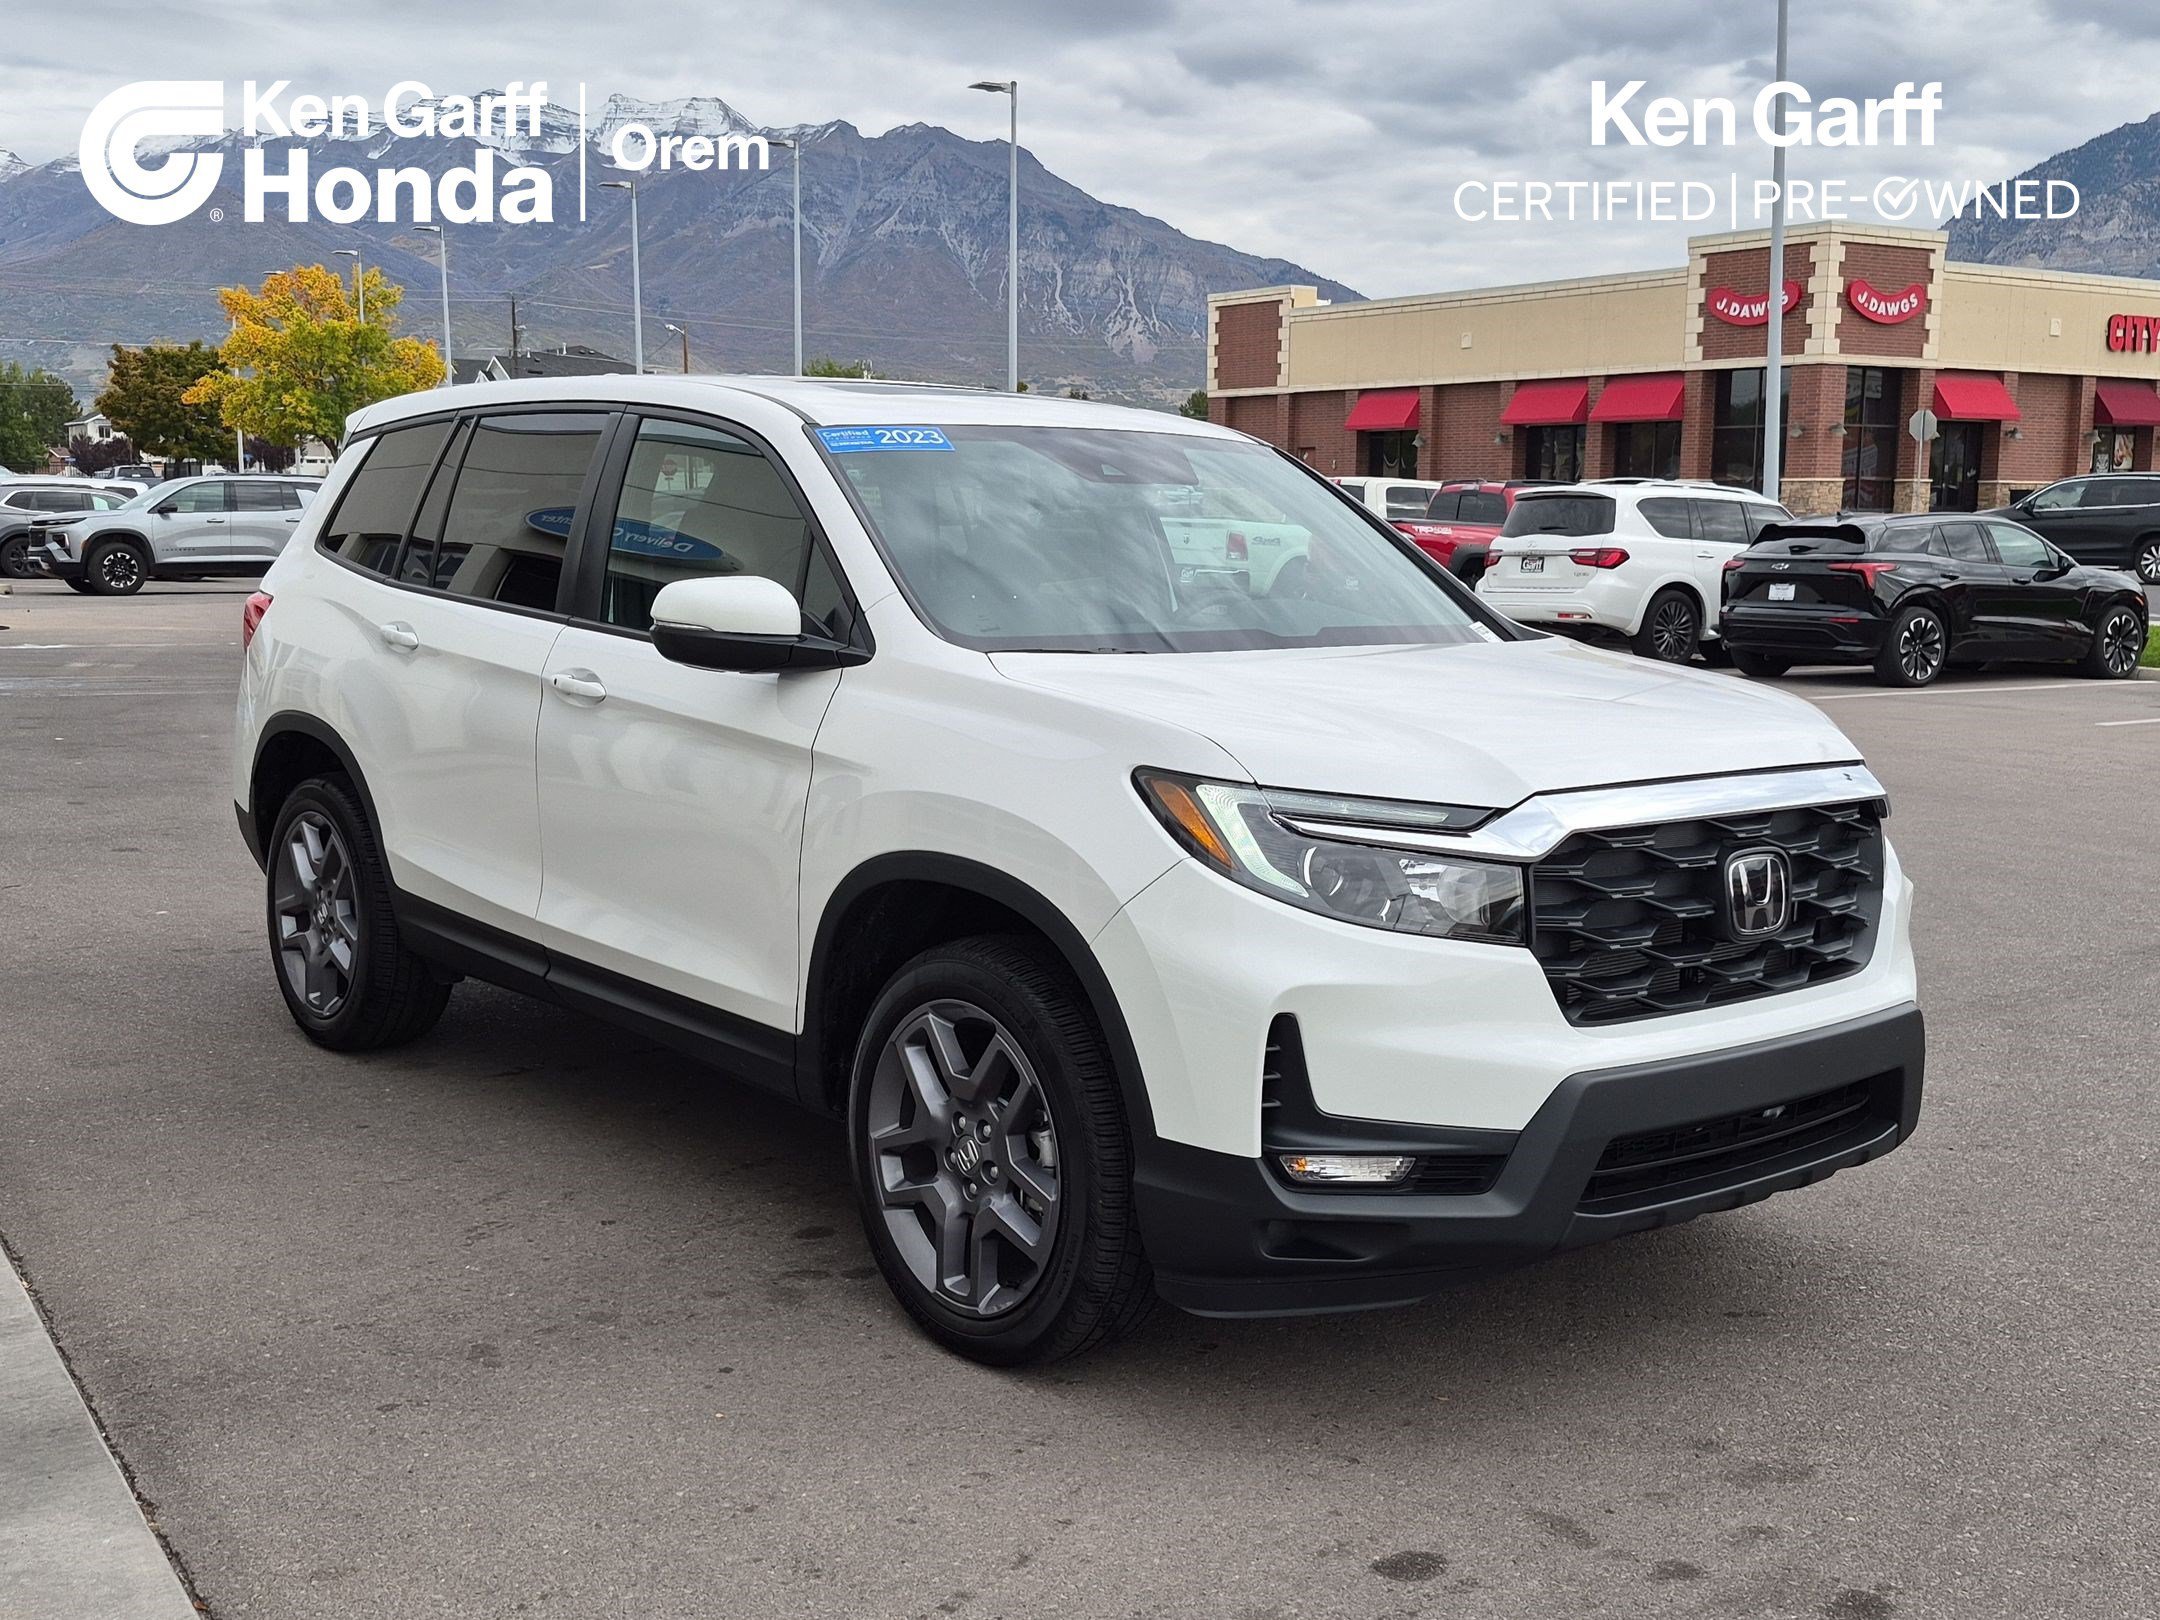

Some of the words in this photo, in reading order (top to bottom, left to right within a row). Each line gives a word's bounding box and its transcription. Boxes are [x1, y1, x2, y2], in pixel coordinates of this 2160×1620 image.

[1716, 291, 1789, 318] J.DAWS
[1857, 292, 1918, 316] J.DAWGS
[875, 429, 944, 444] 2023
